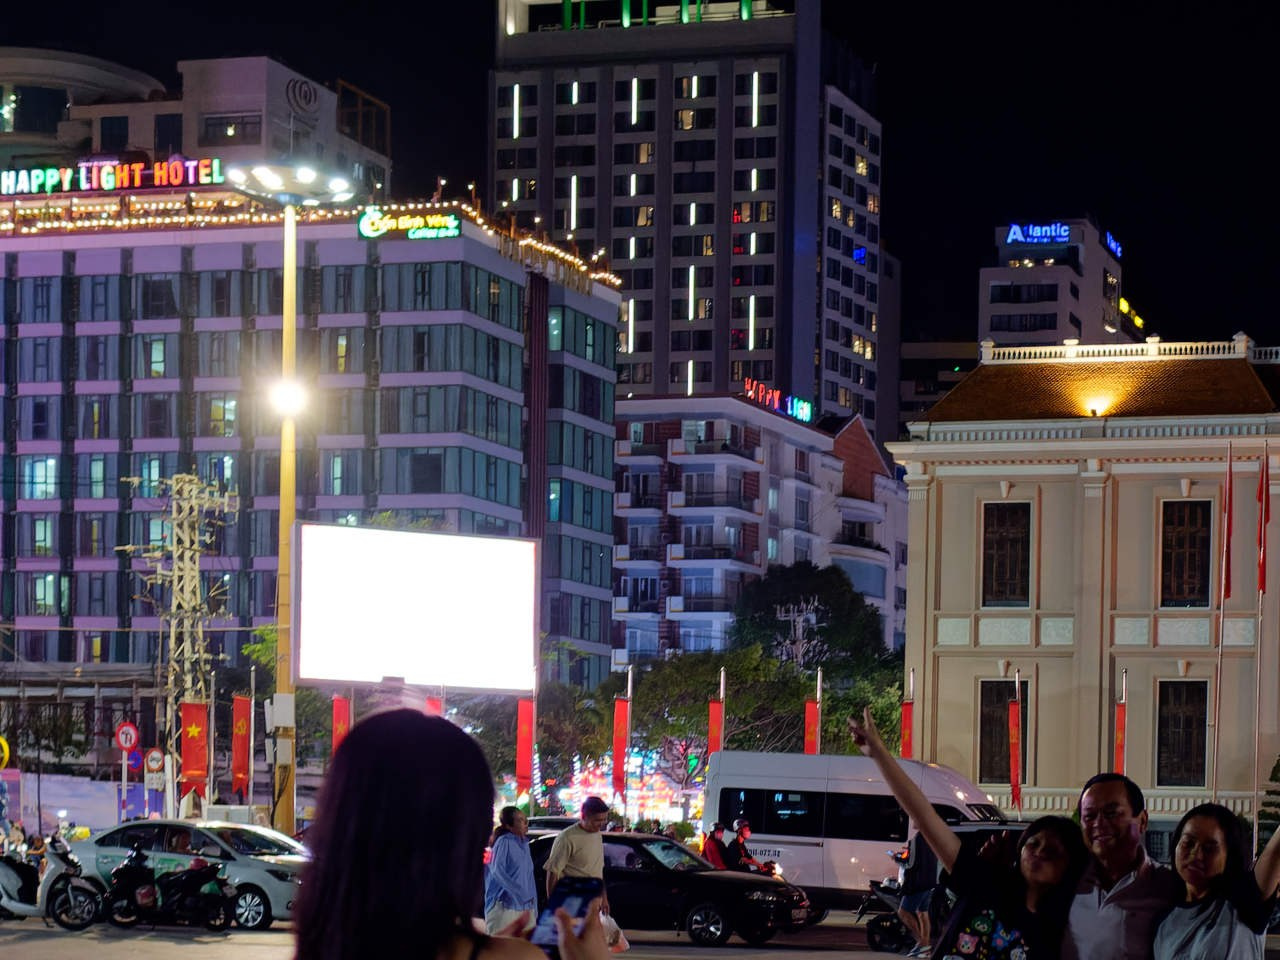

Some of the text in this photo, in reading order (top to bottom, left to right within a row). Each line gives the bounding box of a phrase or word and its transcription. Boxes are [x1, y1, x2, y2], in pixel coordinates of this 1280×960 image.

[1, 158, 225, 195] HAPPY LIGHT HOTEL
